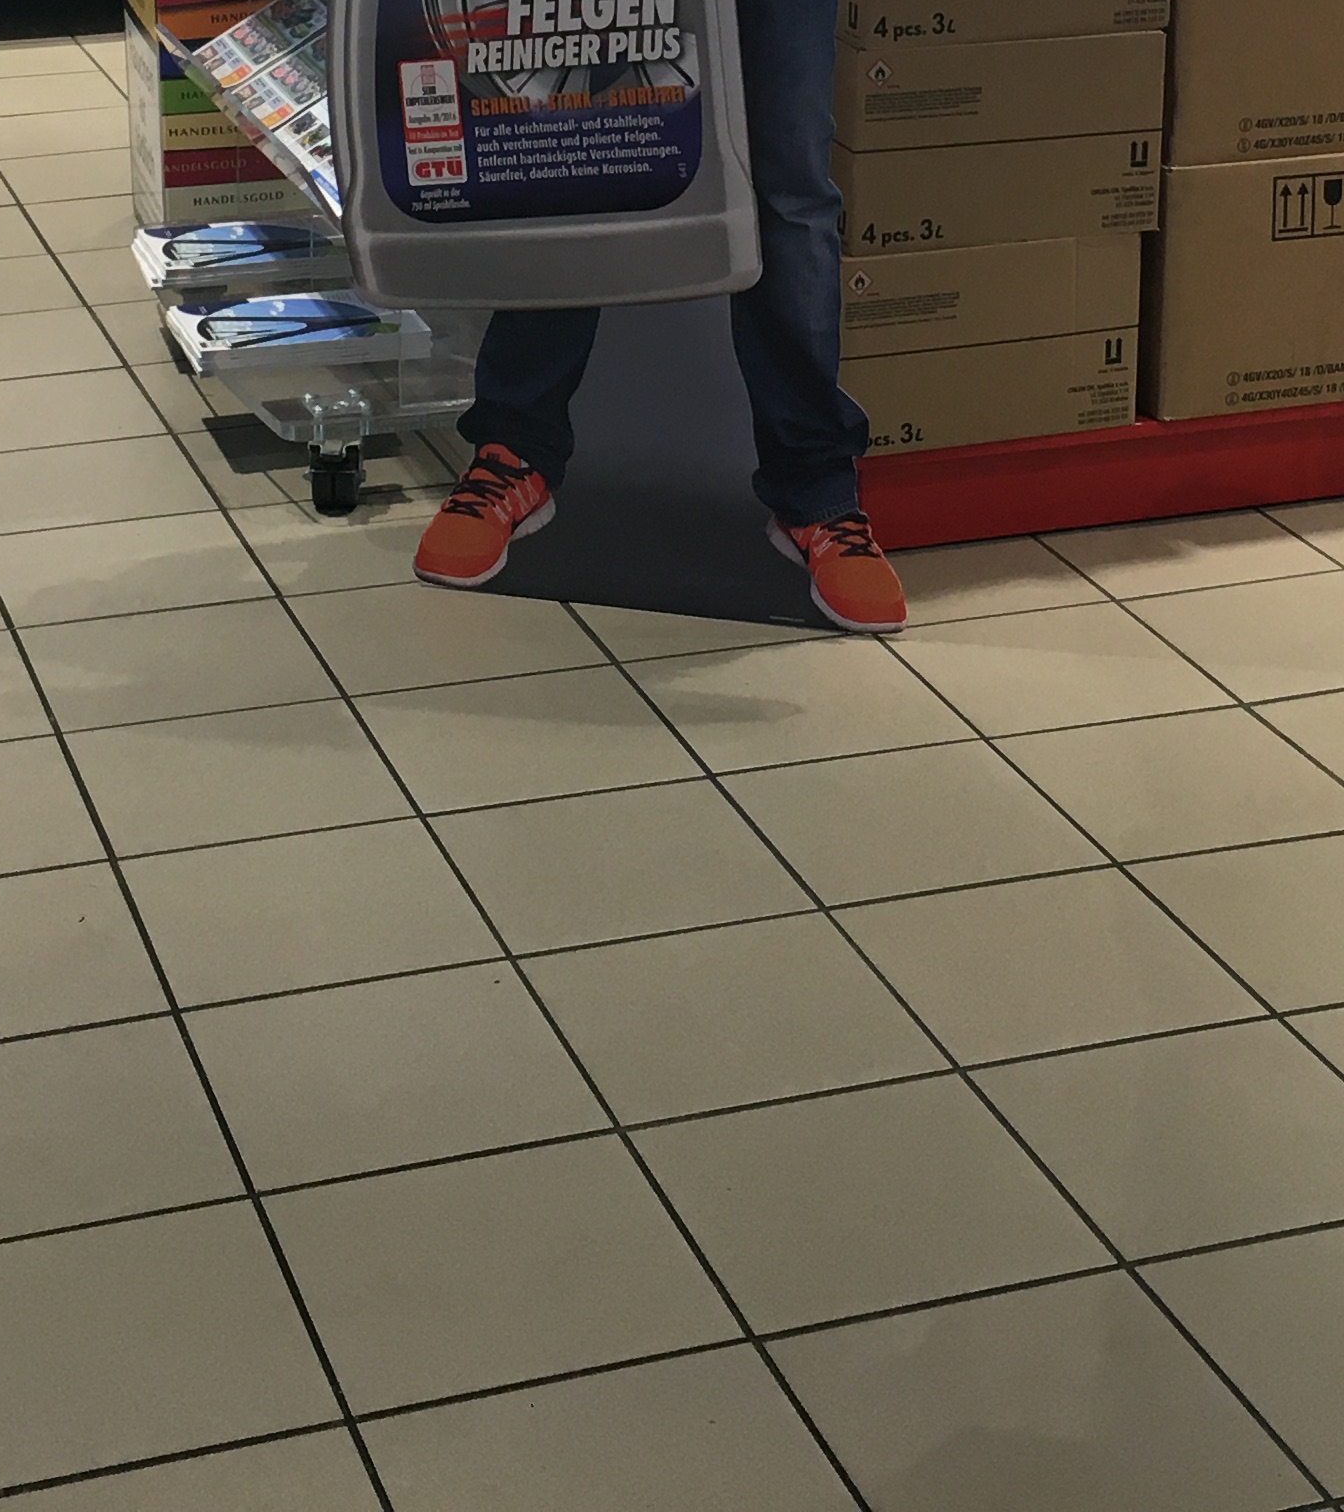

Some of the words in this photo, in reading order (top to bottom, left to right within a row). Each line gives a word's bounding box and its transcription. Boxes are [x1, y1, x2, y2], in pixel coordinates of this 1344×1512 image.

[873, 16, 888, 37] 4
[893, 22, 927, 41] pcs.
[468, 34, 601, 75] REINIGER
[608, 27, 681, 64] PLUS
[471, 95, 530, 116] SCHNELL
[547, 92, 592, 113] STARK
[475, 125, 491, 137] Für
[493, 124, 511, 135] alle
[514, 119, 578, 135] Leichtmetall-
[581, 119, 601, 130] und
[604, 114, 664, 130] Stahlfelgen,
[477, 139, 500, 153] auch
[503, 136, 558, 152] verchromte
[561, 134, 580, 147] und
[582, 131, 622, 147] polierte
[624, 129, 661, 145] Felgen.
[414, 155, 463, 179] GTÜ
[478, 153, 517, 168] Entfernt
[519, 149, 587, 167] hartnäckigste
[589, 143, 682, 160] Verschmutzungen.
[479, 169, 526, 183] Säurefrei,
[529, 164, 569, 179] dadurch
[571, 163, 600, 178] keine
[602, 159, 653, 175] Korrosion.
[193, 191, 284, 207] HANDESGOLD
[862, 223, 876, 244] 4
[881, 229, 915, 247] pcs.
